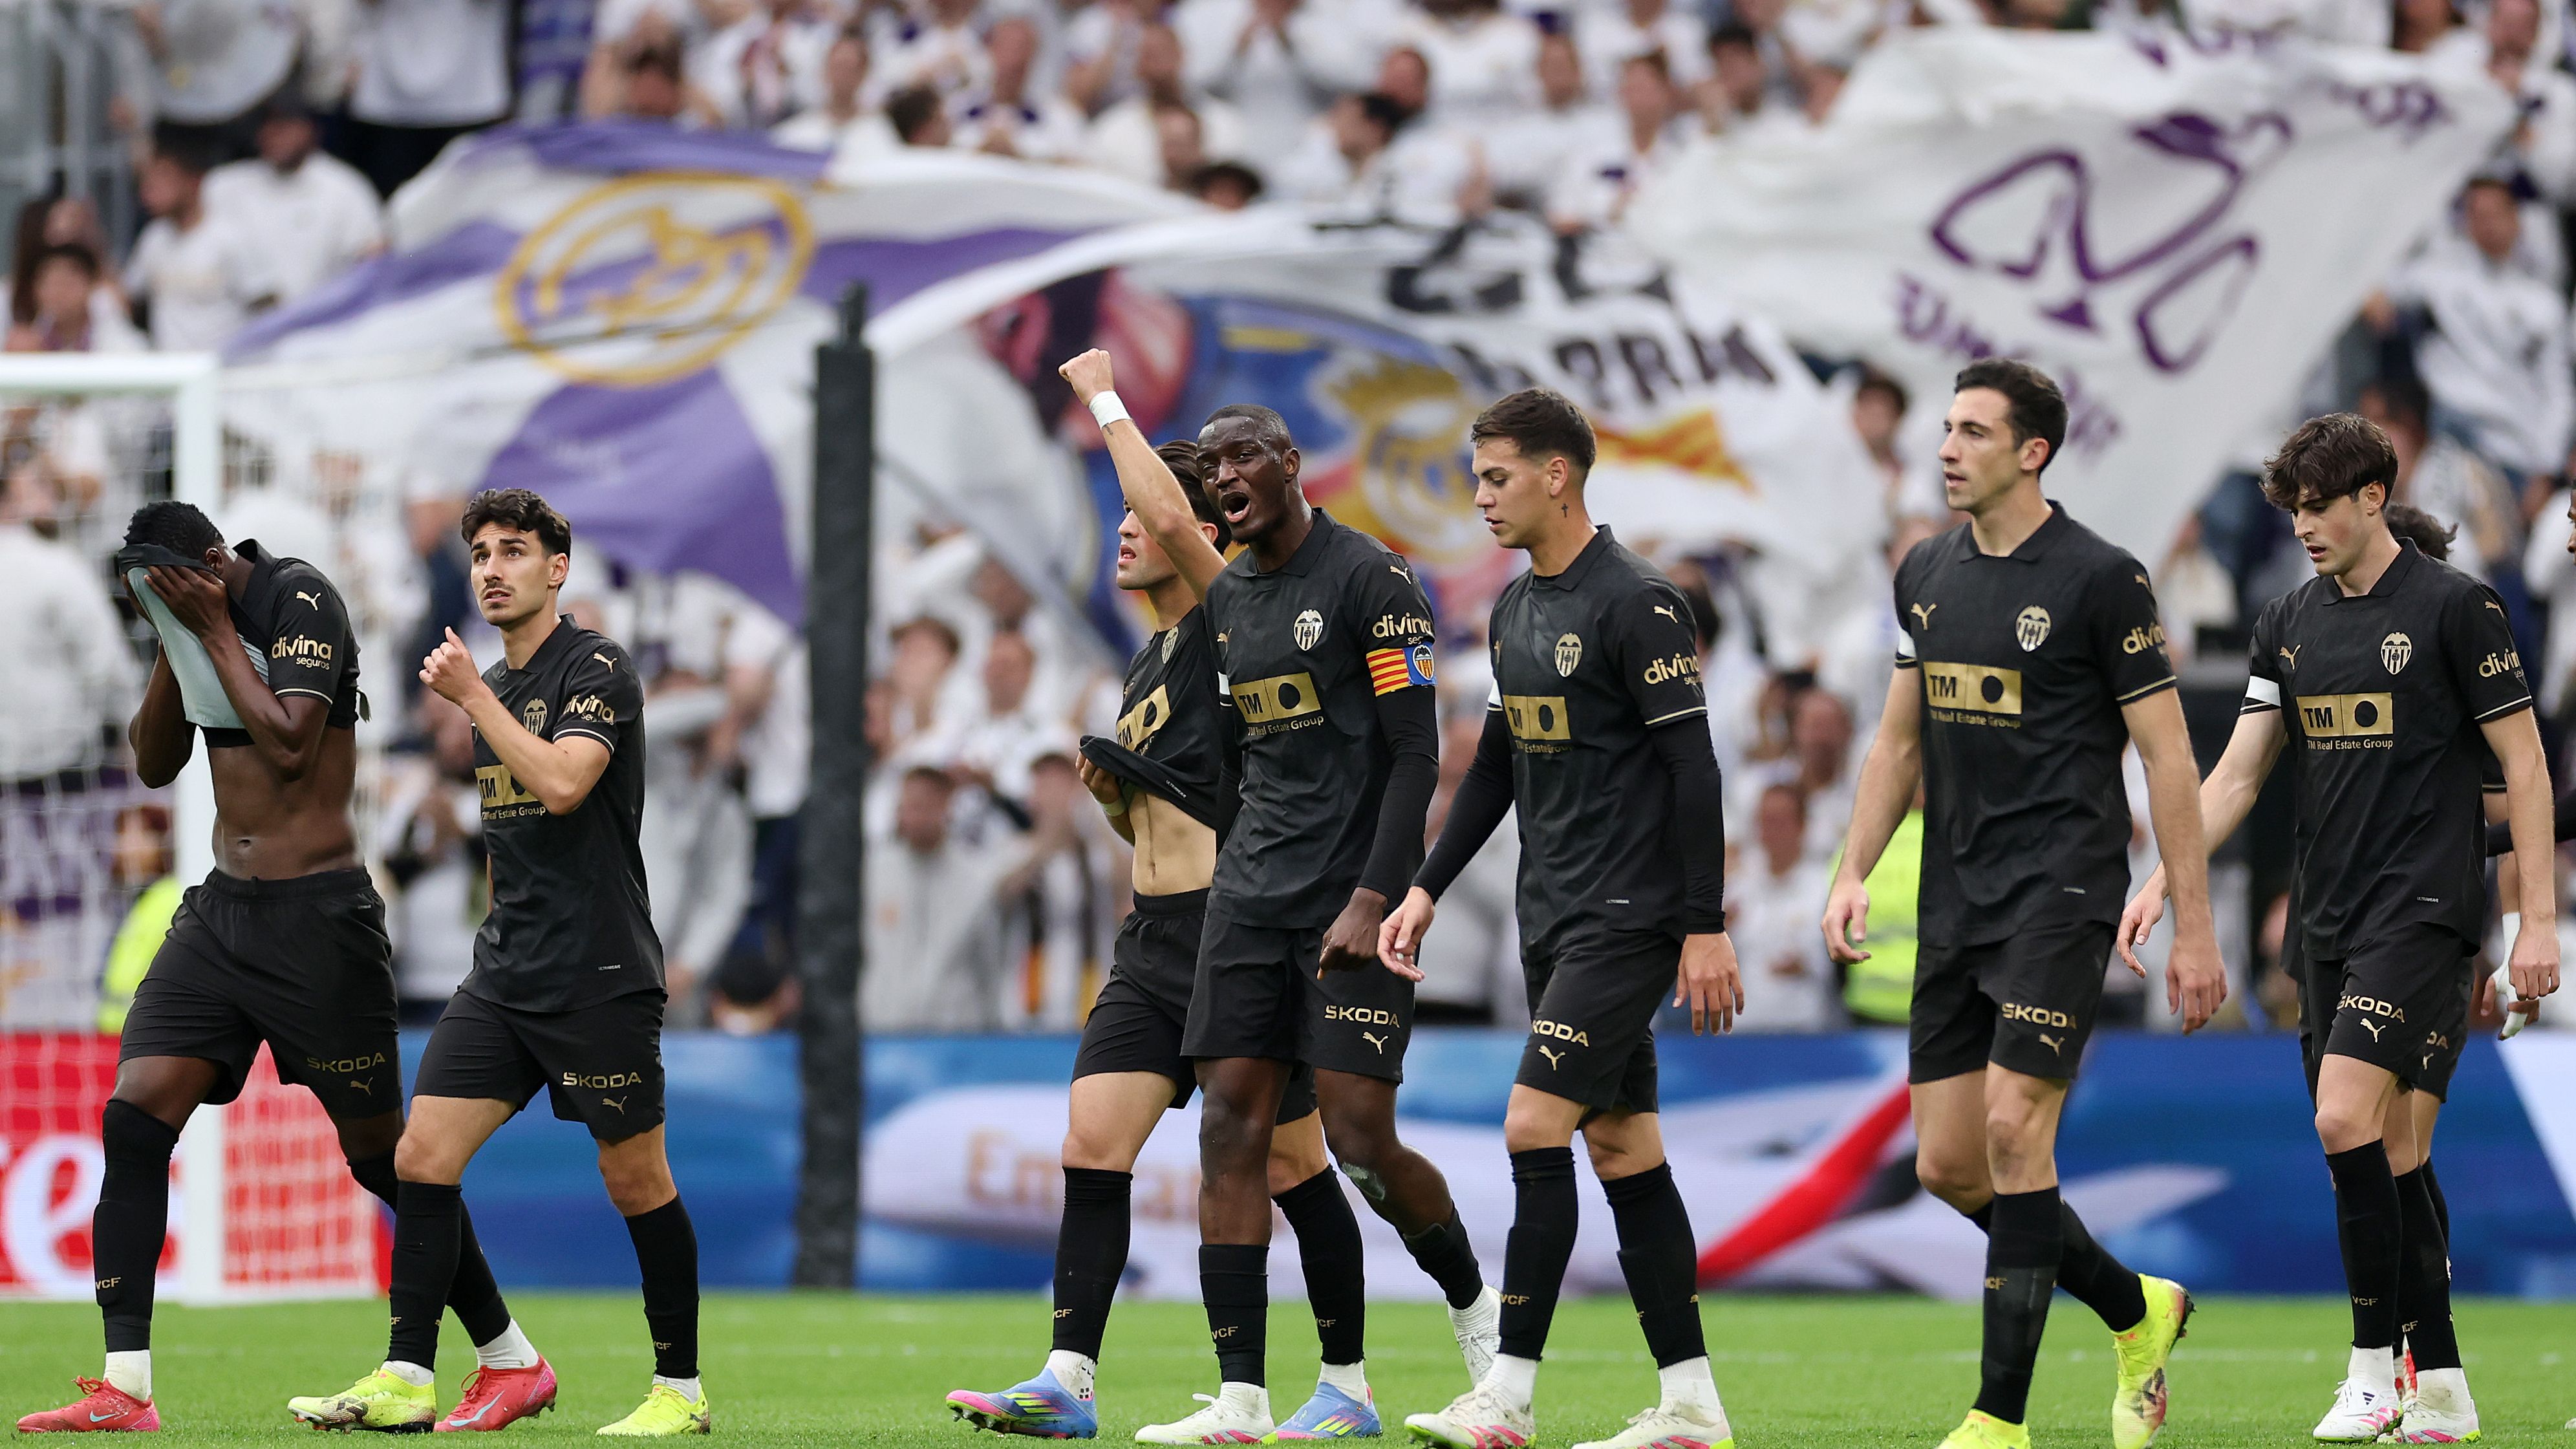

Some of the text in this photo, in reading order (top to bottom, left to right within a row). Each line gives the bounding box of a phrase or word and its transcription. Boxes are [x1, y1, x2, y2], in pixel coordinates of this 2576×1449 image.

[271, 634, 332, 660] divina
[295, 657, 330, 671] seguros
[2478, 647, 2521, 678] divin
[1929, 674, 1957, 698] TM
[1238, 692, 1263, 714] TM
[1267, 724, 1290, 734] Estate
[1290, 715, 1324, 730] Group
[2304, 707, 2334, 729] TM
[2306, 738, 2394, 750] TM Real Estate Group
[478, 777, 497, 800] TM
[519, 806, 546, 817] Group
[1532, 1020, 1589, 1047] KODA
[2352, 1295, 2379, 1306] VCF
[1212, 1326, 1238, 1340] VCF
